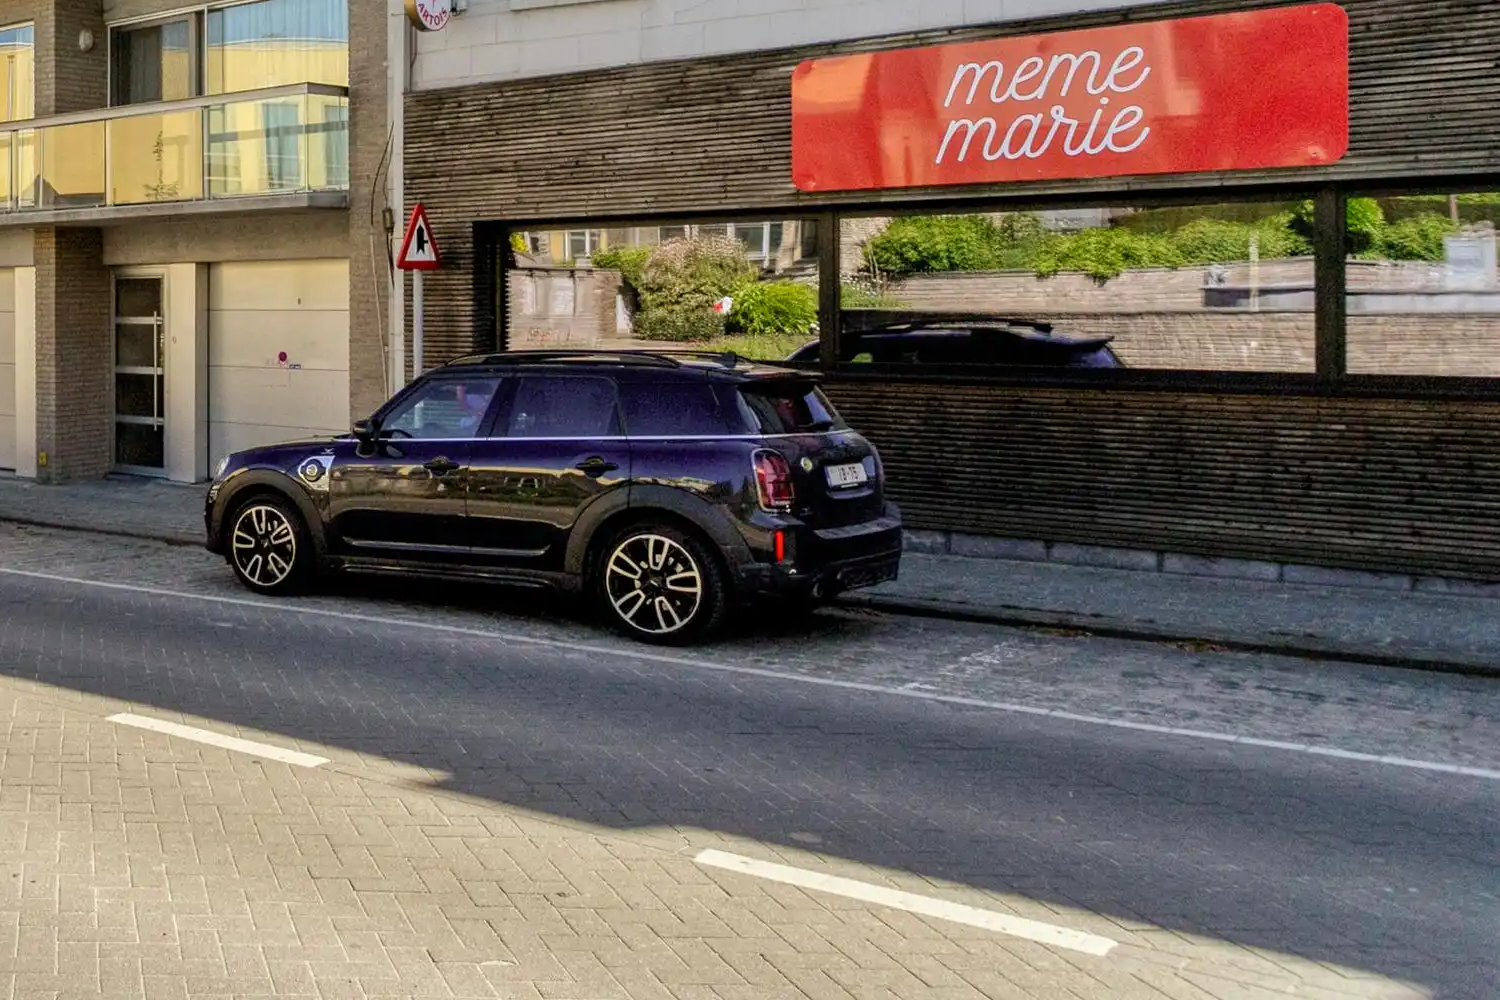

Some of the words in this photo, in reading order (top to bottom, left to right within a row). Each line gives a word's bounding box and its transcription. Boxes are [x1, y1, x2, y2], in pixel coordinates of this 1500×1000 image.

[418, 3, 447, 25] ARTOIS
[944, 46, 1151, 107] meme
[935, 97, 1150, 164] marie
